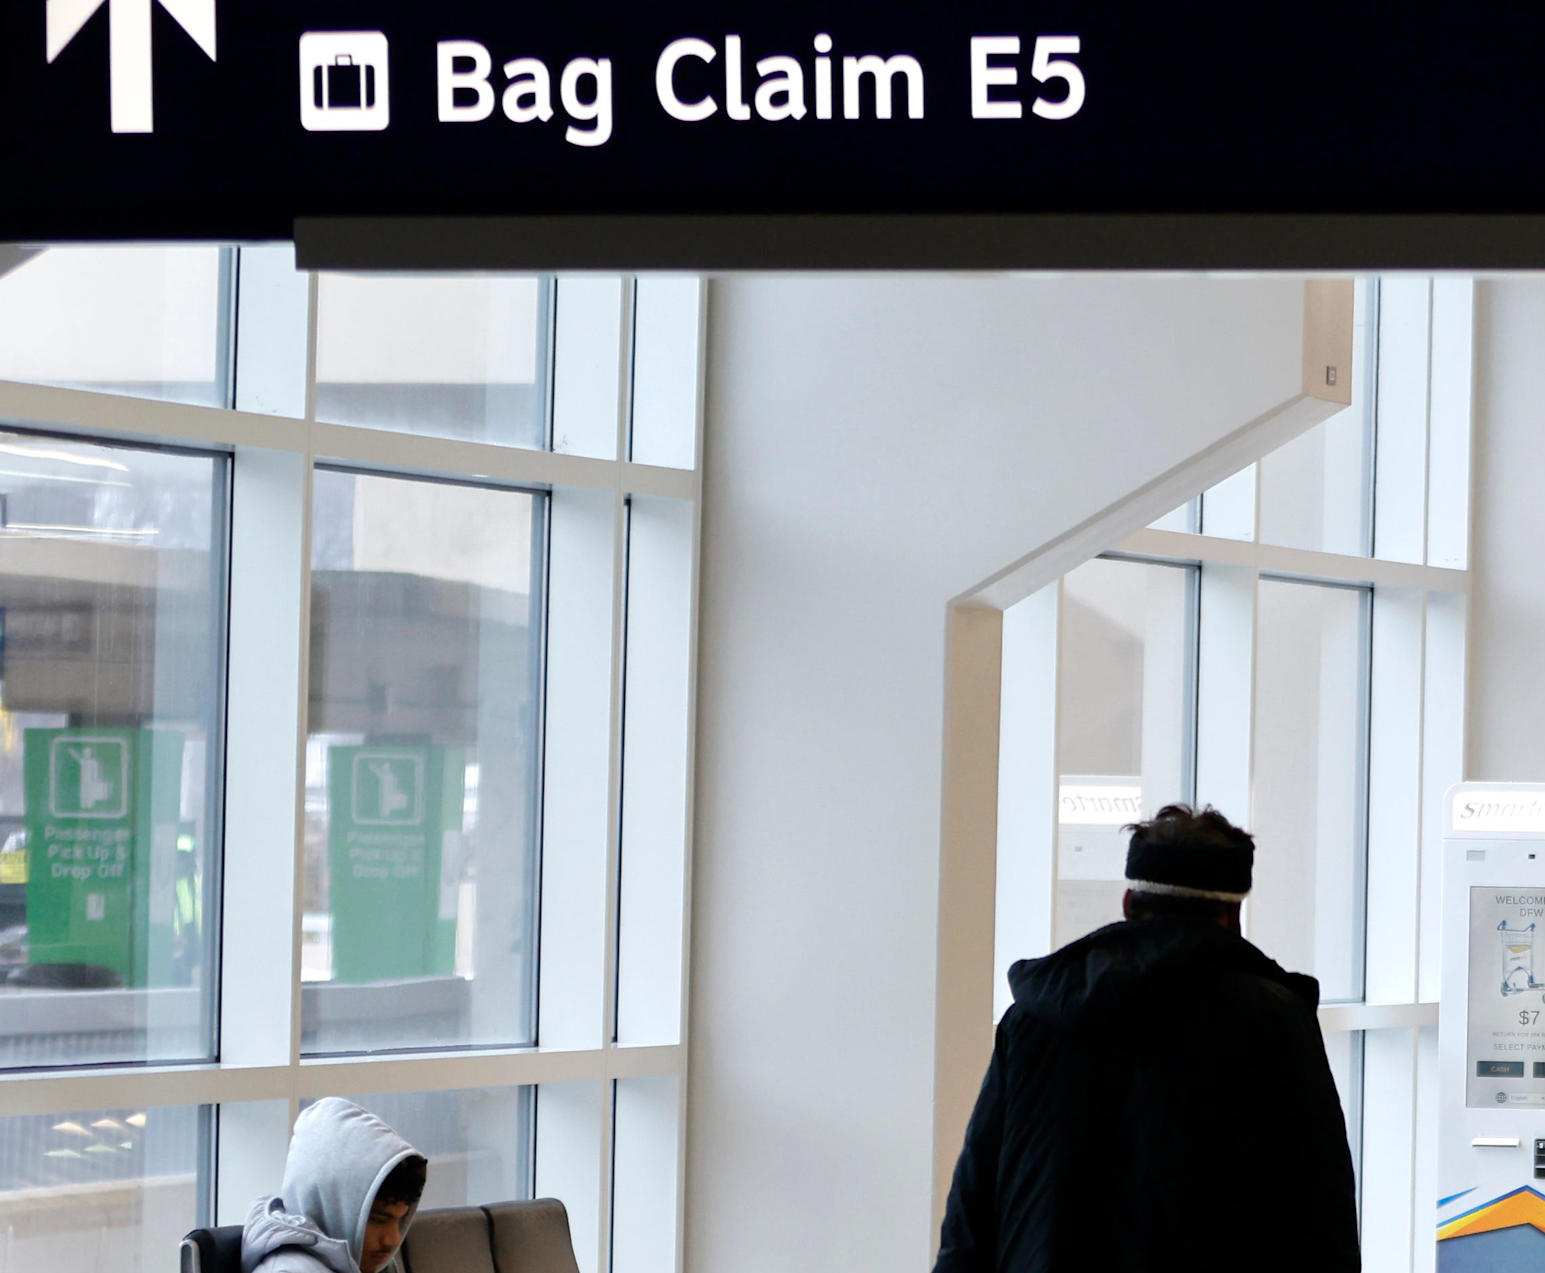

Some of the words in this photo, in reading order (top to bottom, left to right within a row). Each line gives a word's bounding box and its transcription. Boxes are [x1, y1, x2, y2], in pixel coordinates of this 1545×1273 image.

[437, 39, 613, 147] Bag
[655, 33, 925, 122] Claim
[970, 35, 1086, 120] E5
[45, 826, 130, 844] Passenger
[51, 863, 91, 879] Drop
[98, 863, 124, 878] Off
[1519, 908, 1544, 918] DFW
[1518, 1010, 1540, 1027] $7
[1494, 1043, 1524, 1051] SELECT
